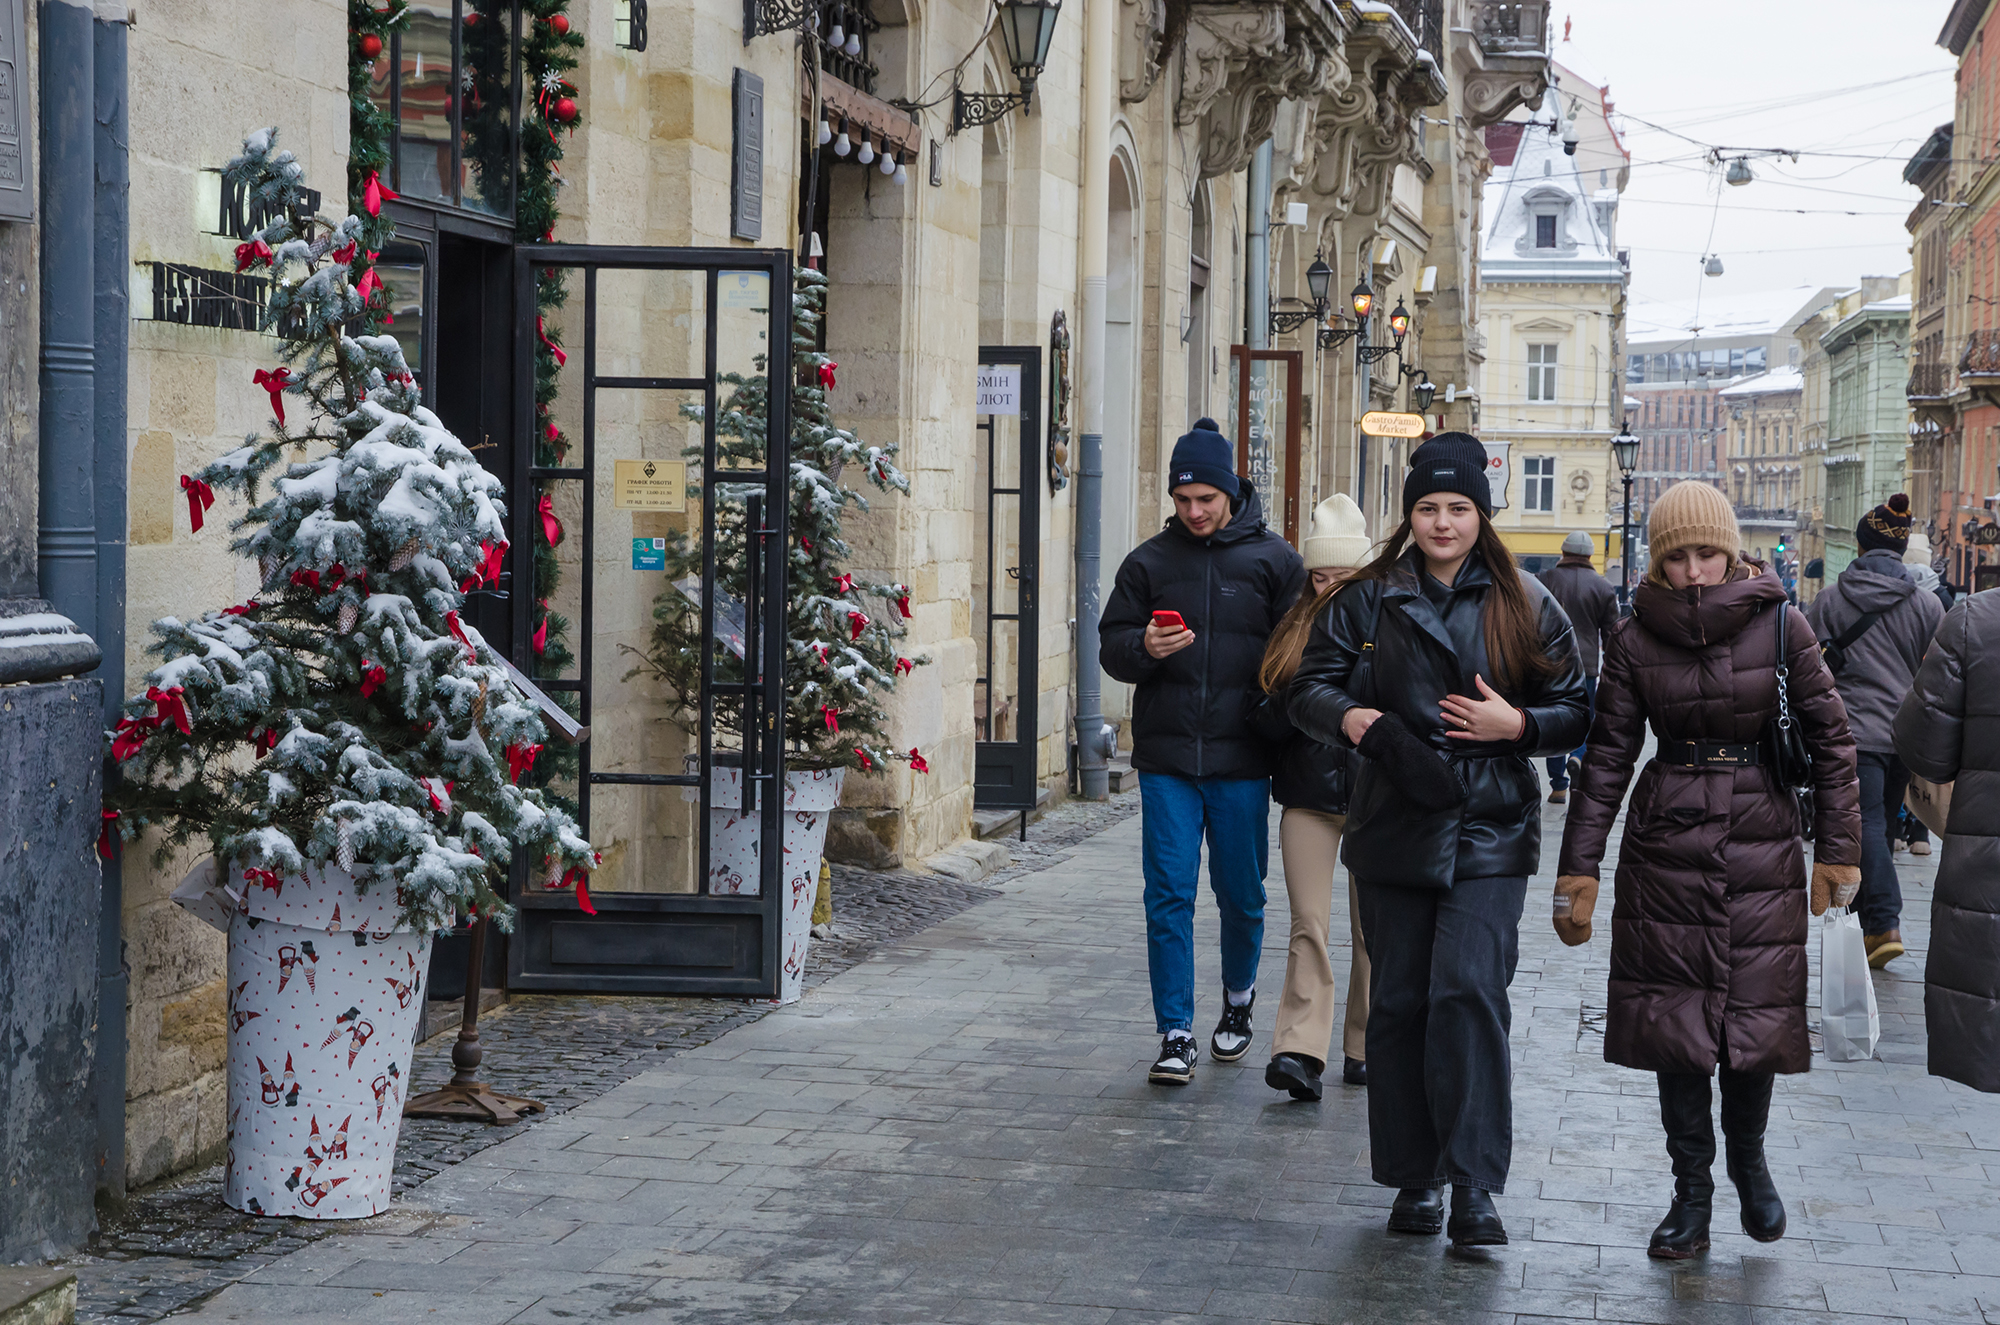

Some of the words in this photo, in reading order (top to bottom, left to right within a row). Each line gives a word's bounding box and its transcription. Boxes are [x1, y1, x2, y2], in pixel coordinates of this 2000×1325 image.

[976, 393, 1012, 405] ЛЮТ
[1376, 424, 1408, 434] Market
[1909, 783, 1932, 806] SH
